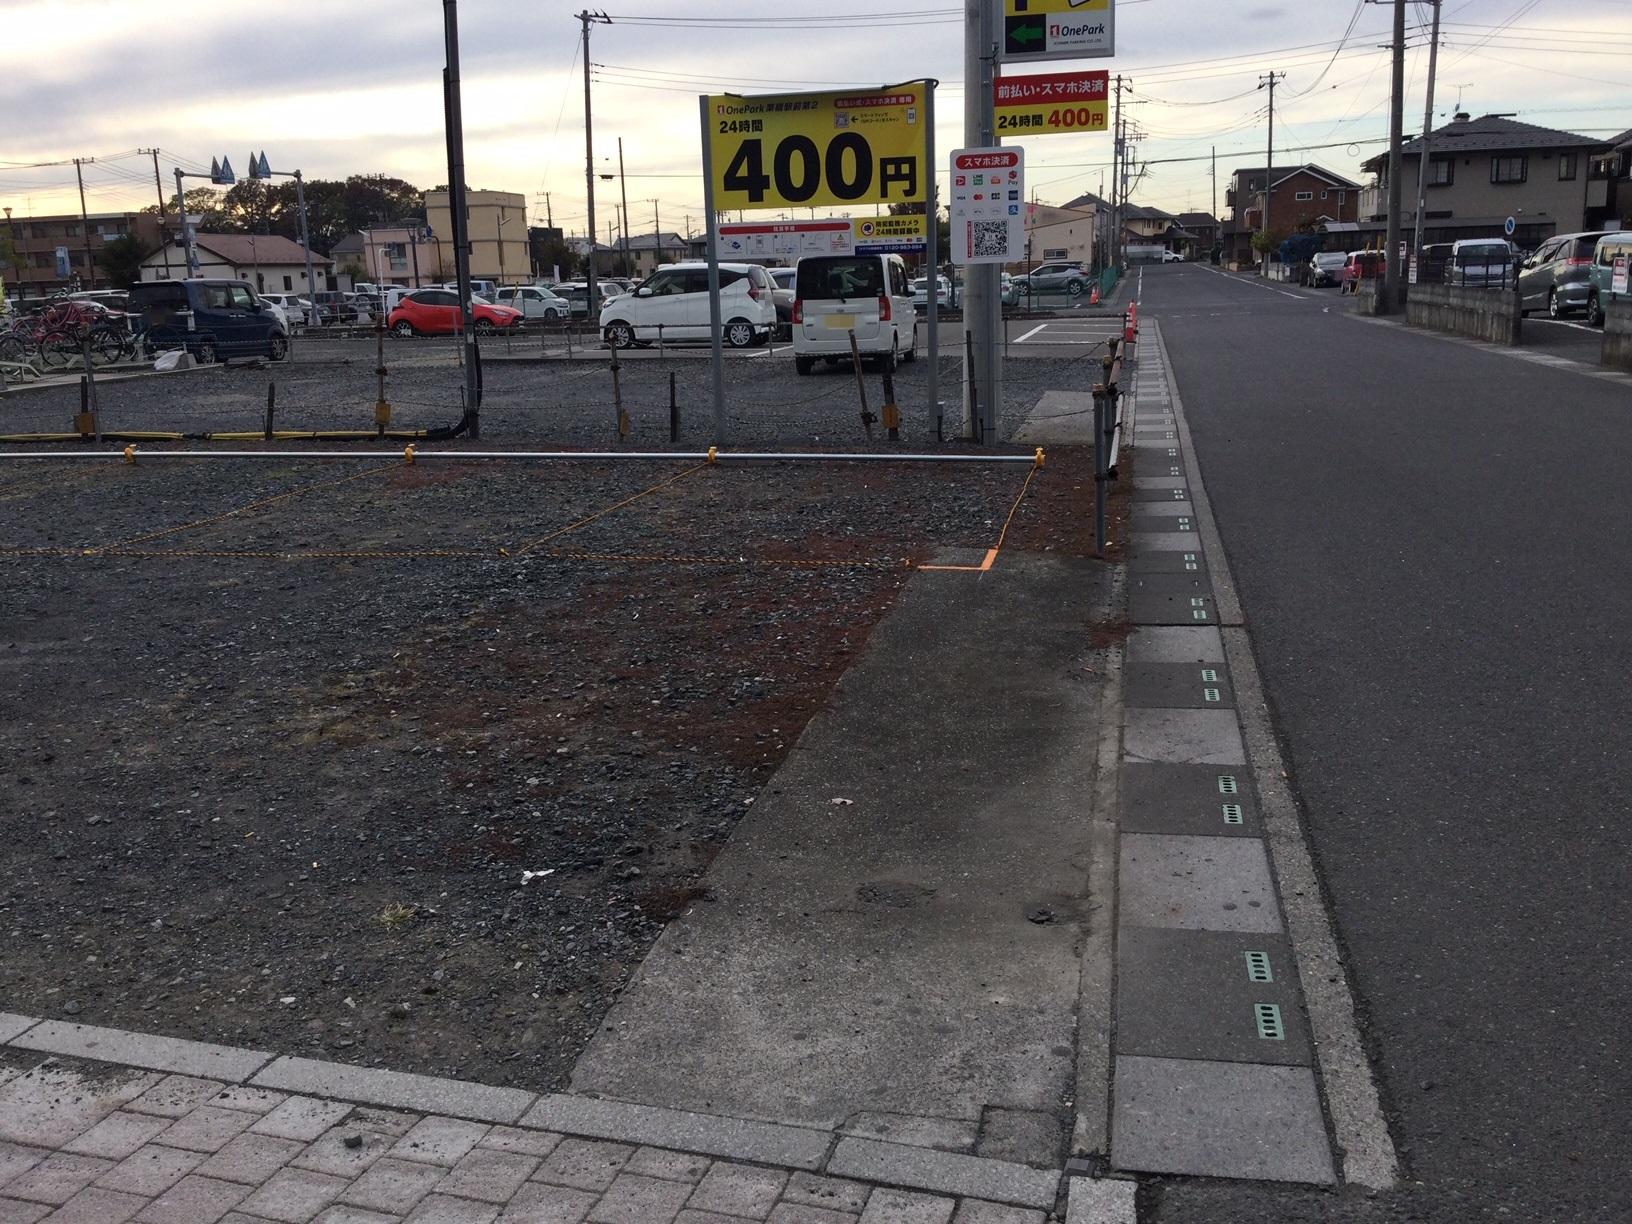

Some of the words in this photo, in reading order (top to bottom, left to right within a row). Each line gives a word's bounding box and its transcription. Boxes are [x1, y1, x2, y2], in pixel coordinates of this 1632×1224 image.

[1061, 23, 1105, 37] OnePark
[998, 80, 1104, 98] 前払い・スマホ決済
[726, 104, 764, 115] OnePark
[998, 114, 1043, 129] 24時間
[1048, 108, 1104, 128] 400円
[720, 119, 763, 134] 24時間
[964, 156, 1009, 167] スマホ決済
